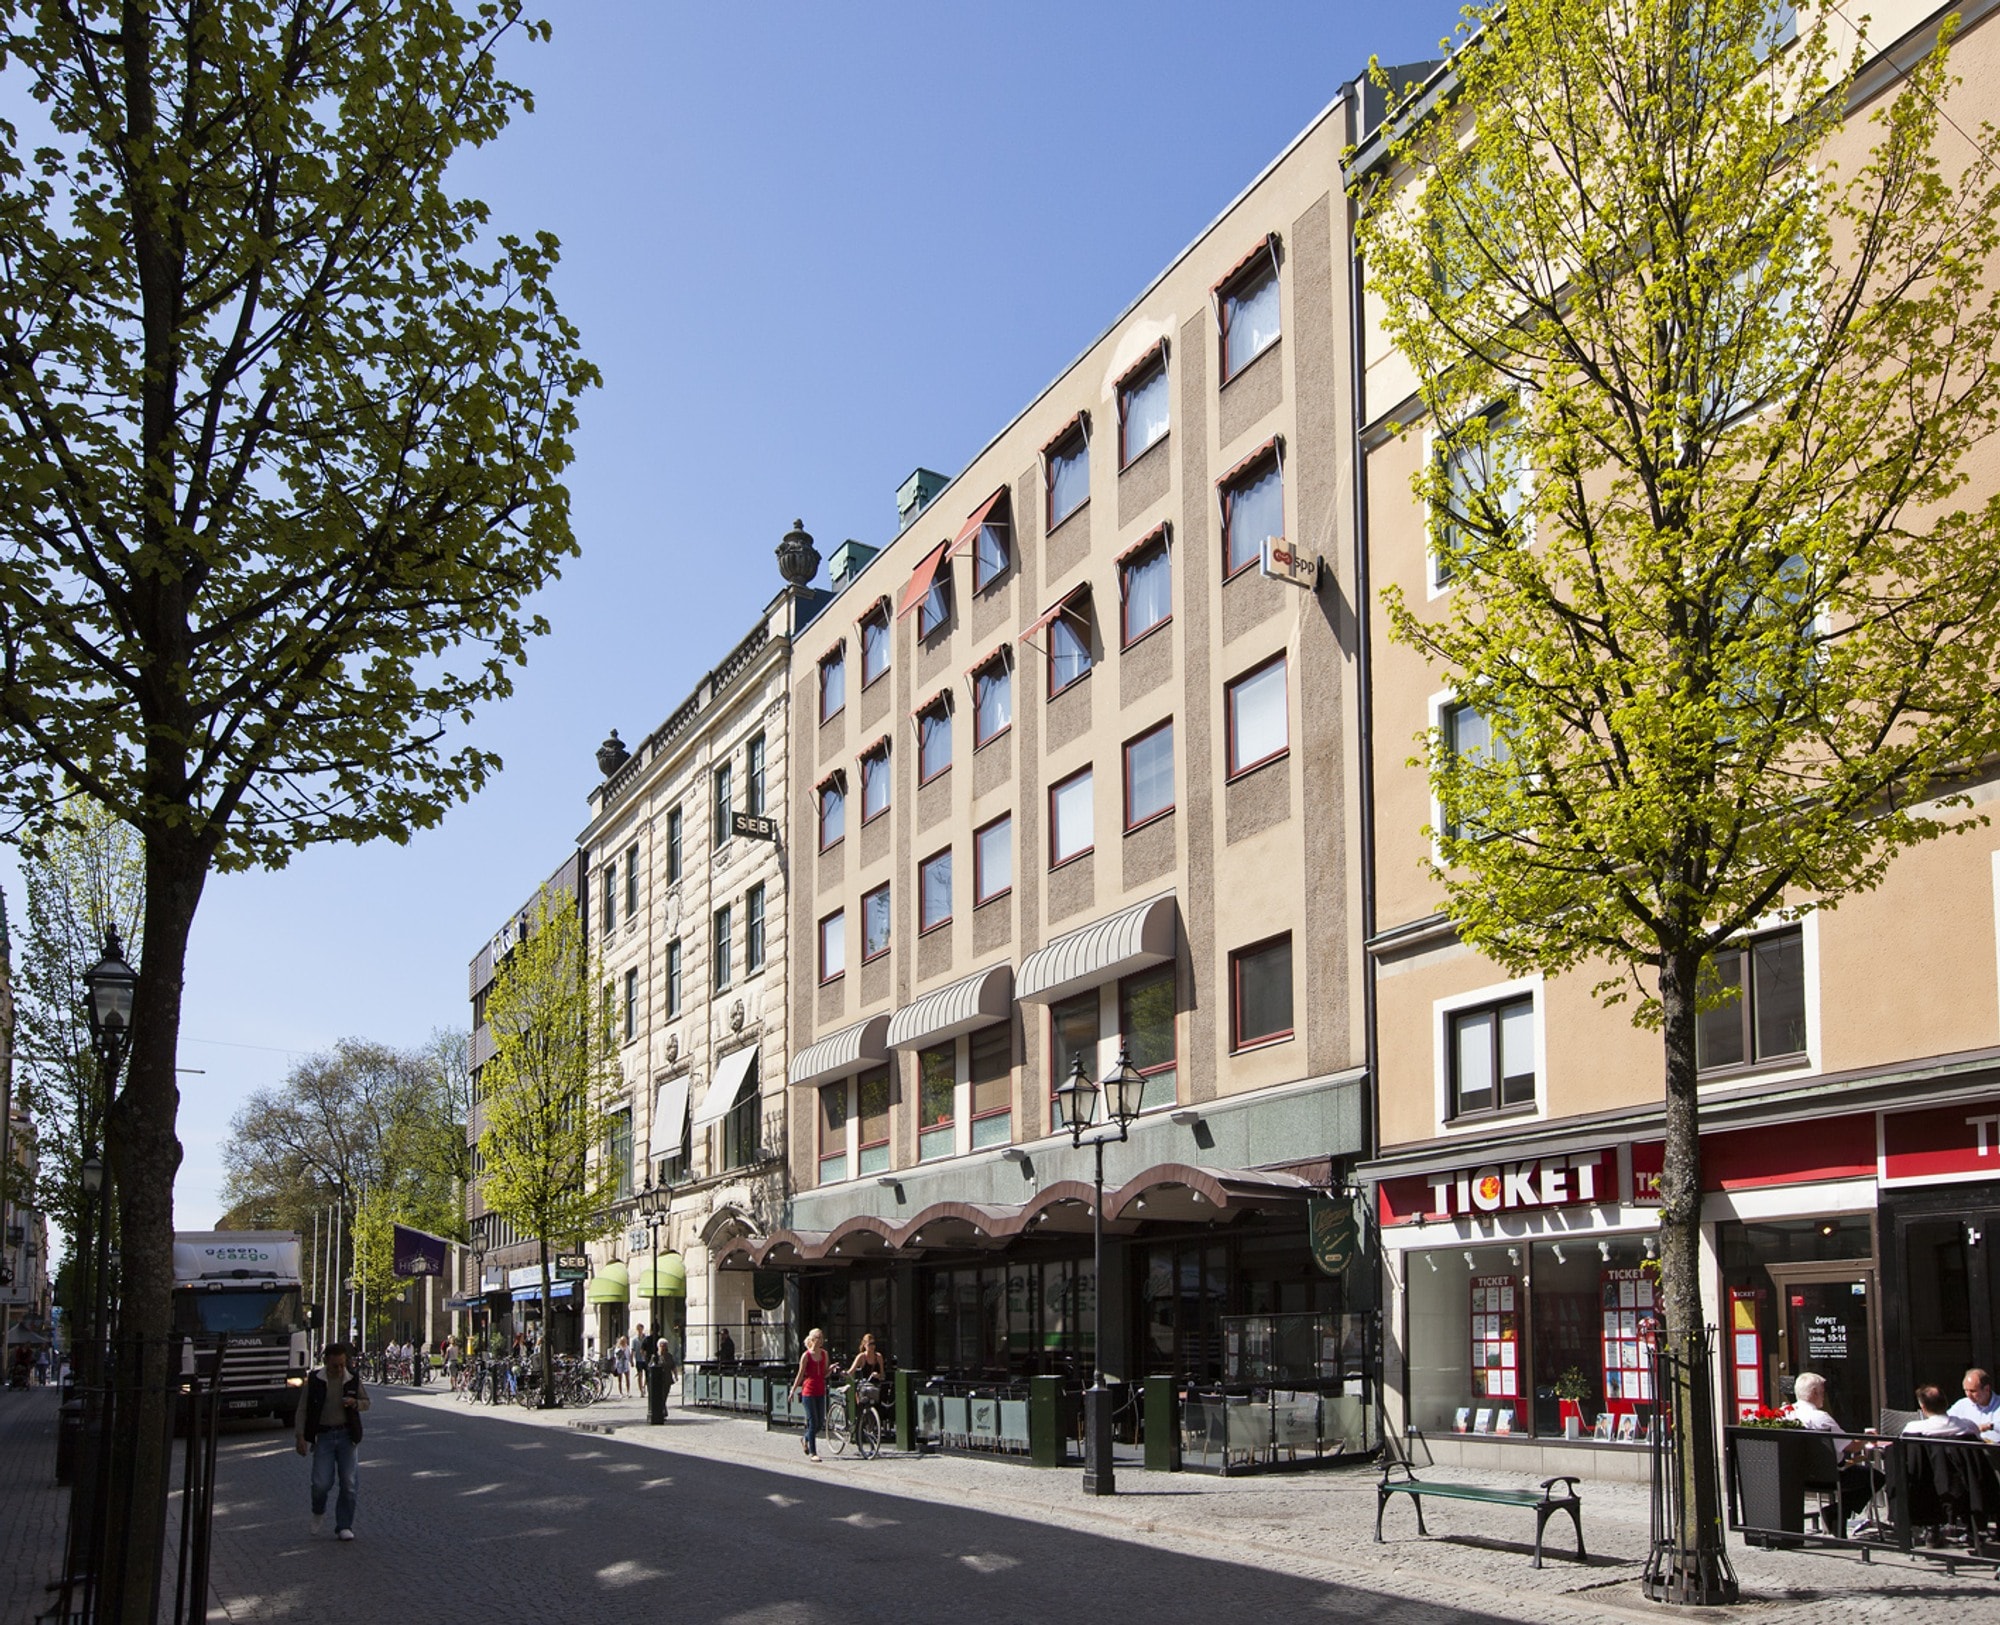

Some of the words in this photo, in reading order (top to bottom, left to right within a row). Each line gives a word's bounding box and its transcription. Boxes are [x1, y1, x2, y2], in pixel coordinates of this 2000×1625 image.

[736, 816, 769, 834] SEB
[1427, 1151, 1602, 1216] TICKET
[205, 1247, 258, 1256] green
[216, 1252, 269, 1262] cargo
[559, 1256, 586, 1268] SEB
[1607, 1268, 1645, 1280] TICKET
[1478, 1275, 1509, 1287] TICKET
